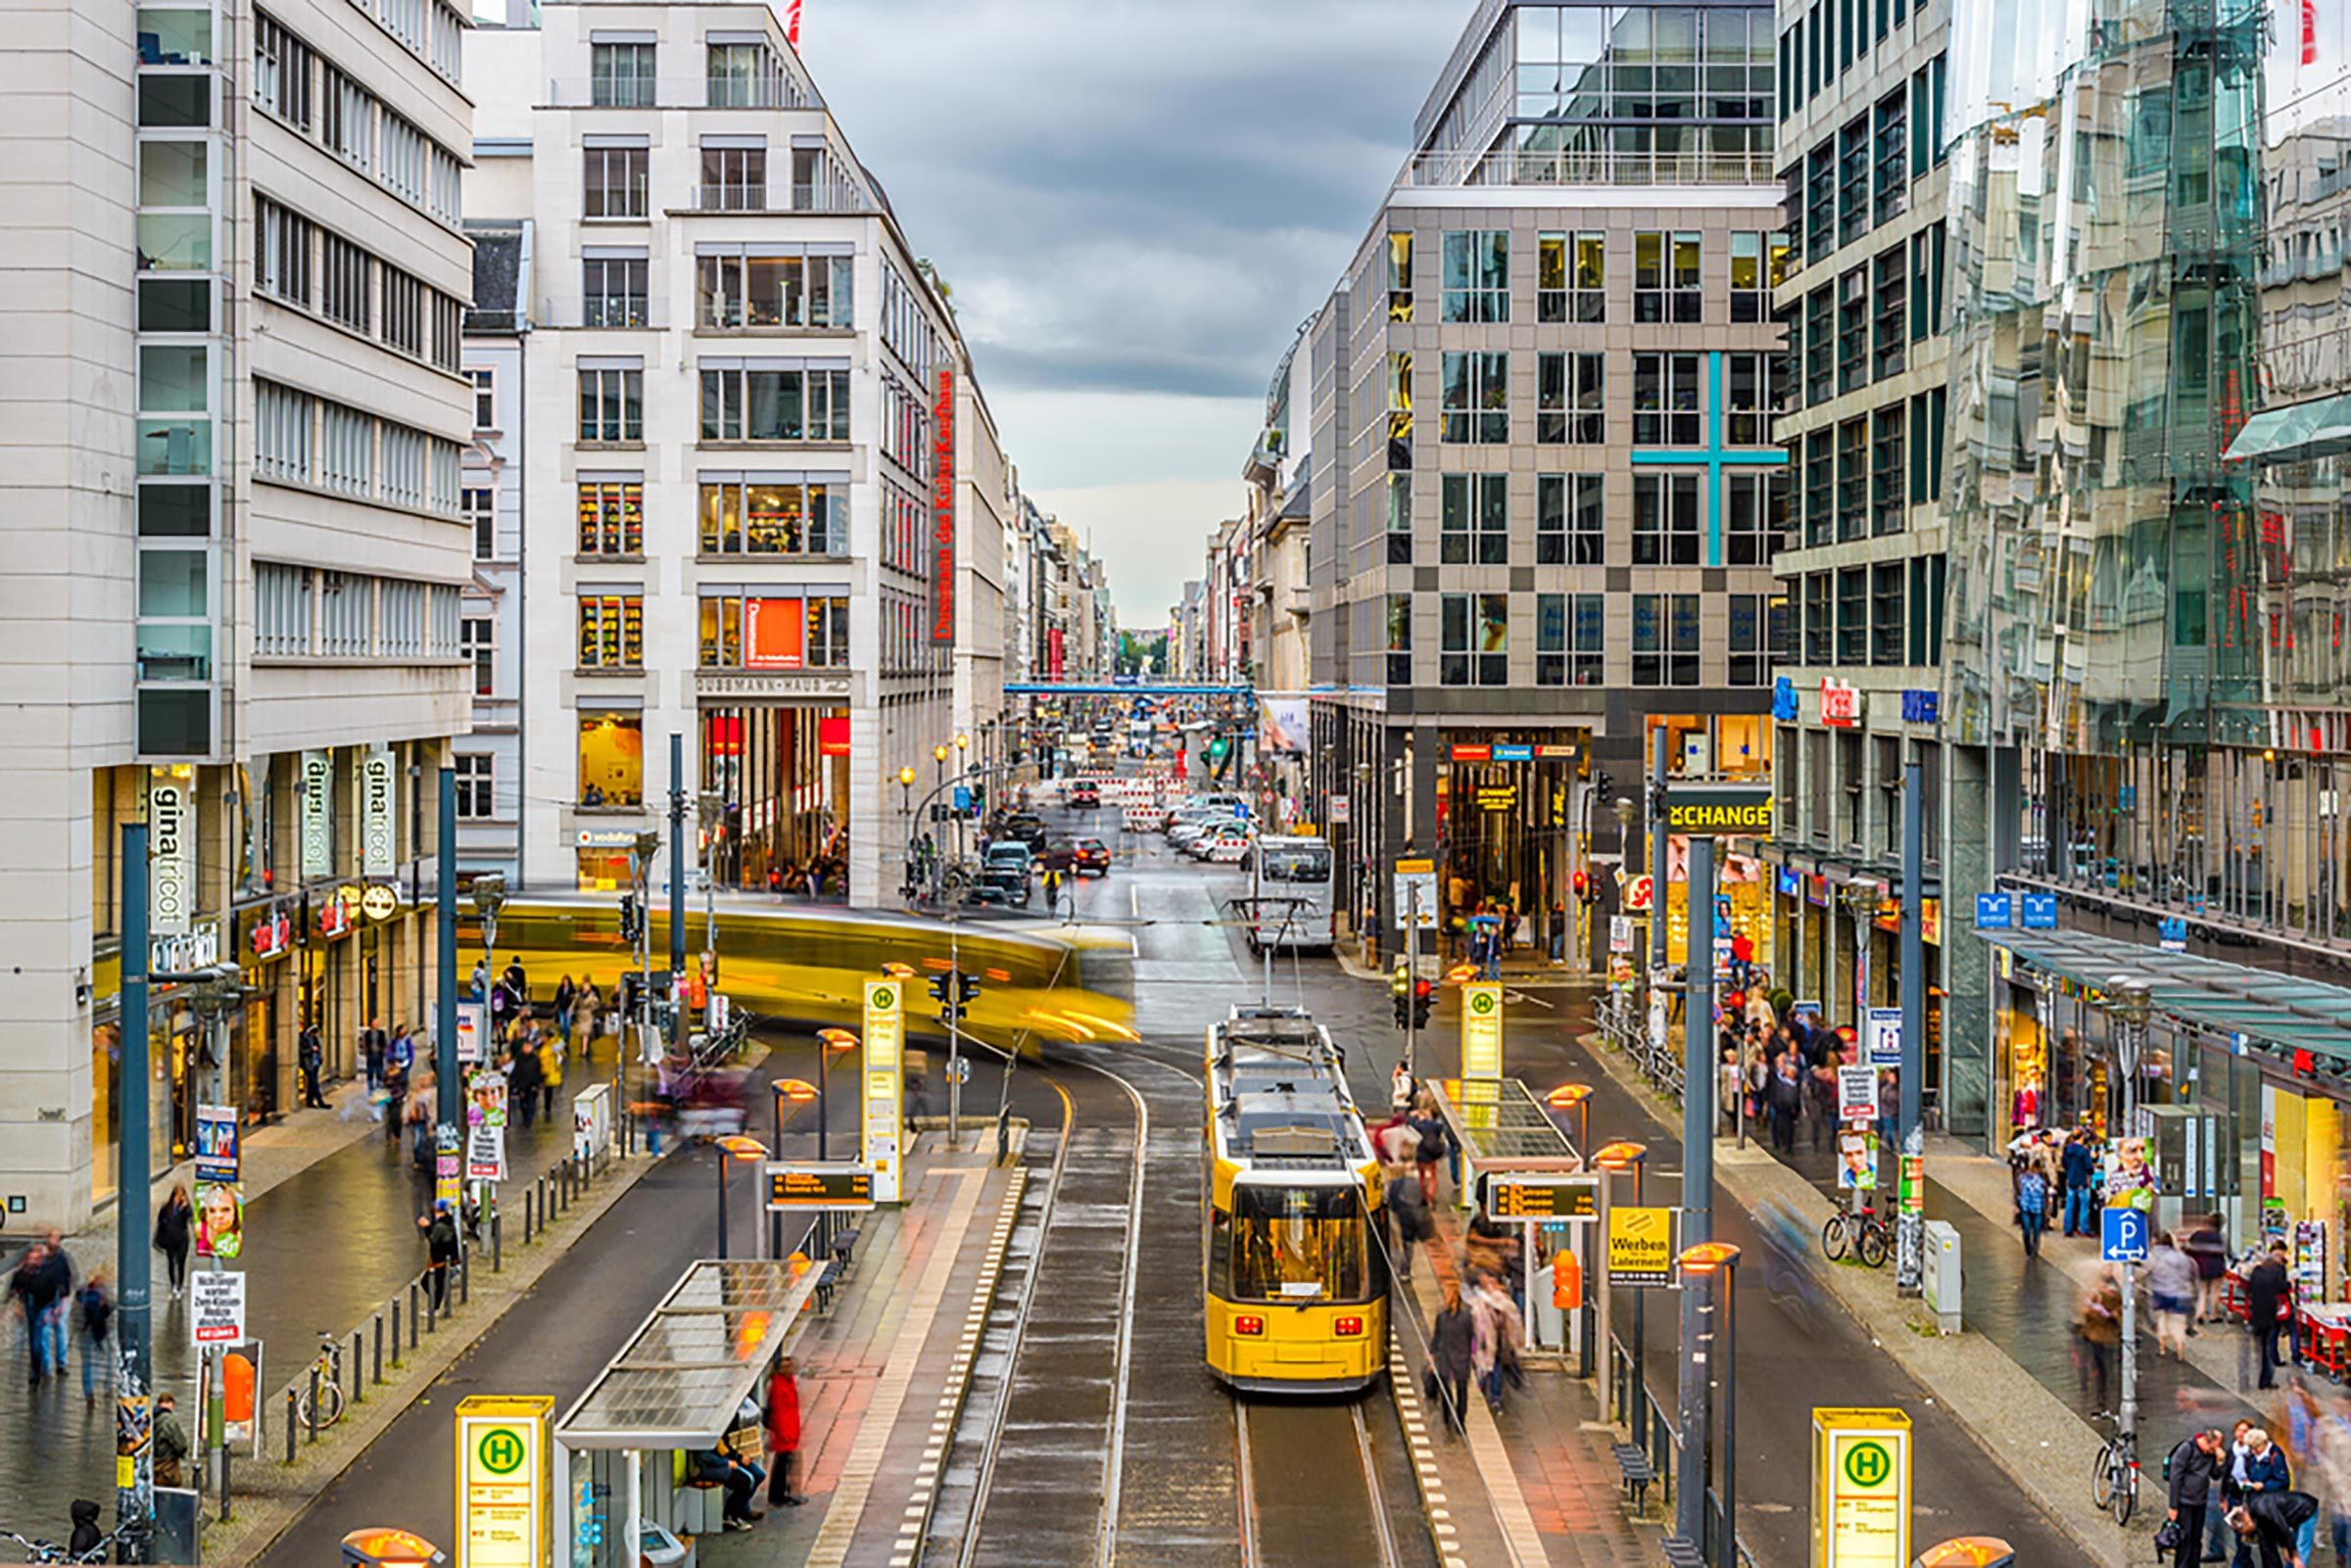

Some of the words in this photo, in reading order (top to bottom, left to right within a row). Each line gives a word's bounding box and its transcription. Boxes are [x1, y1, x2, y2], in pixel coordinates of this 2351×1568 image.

[1611, 1237, 1666, 1250] Werben
[2121, 1220, 2137, 1248] P
[491, 1439, 512, 1464] H
[1856, 1451, 1878, 1477] H
